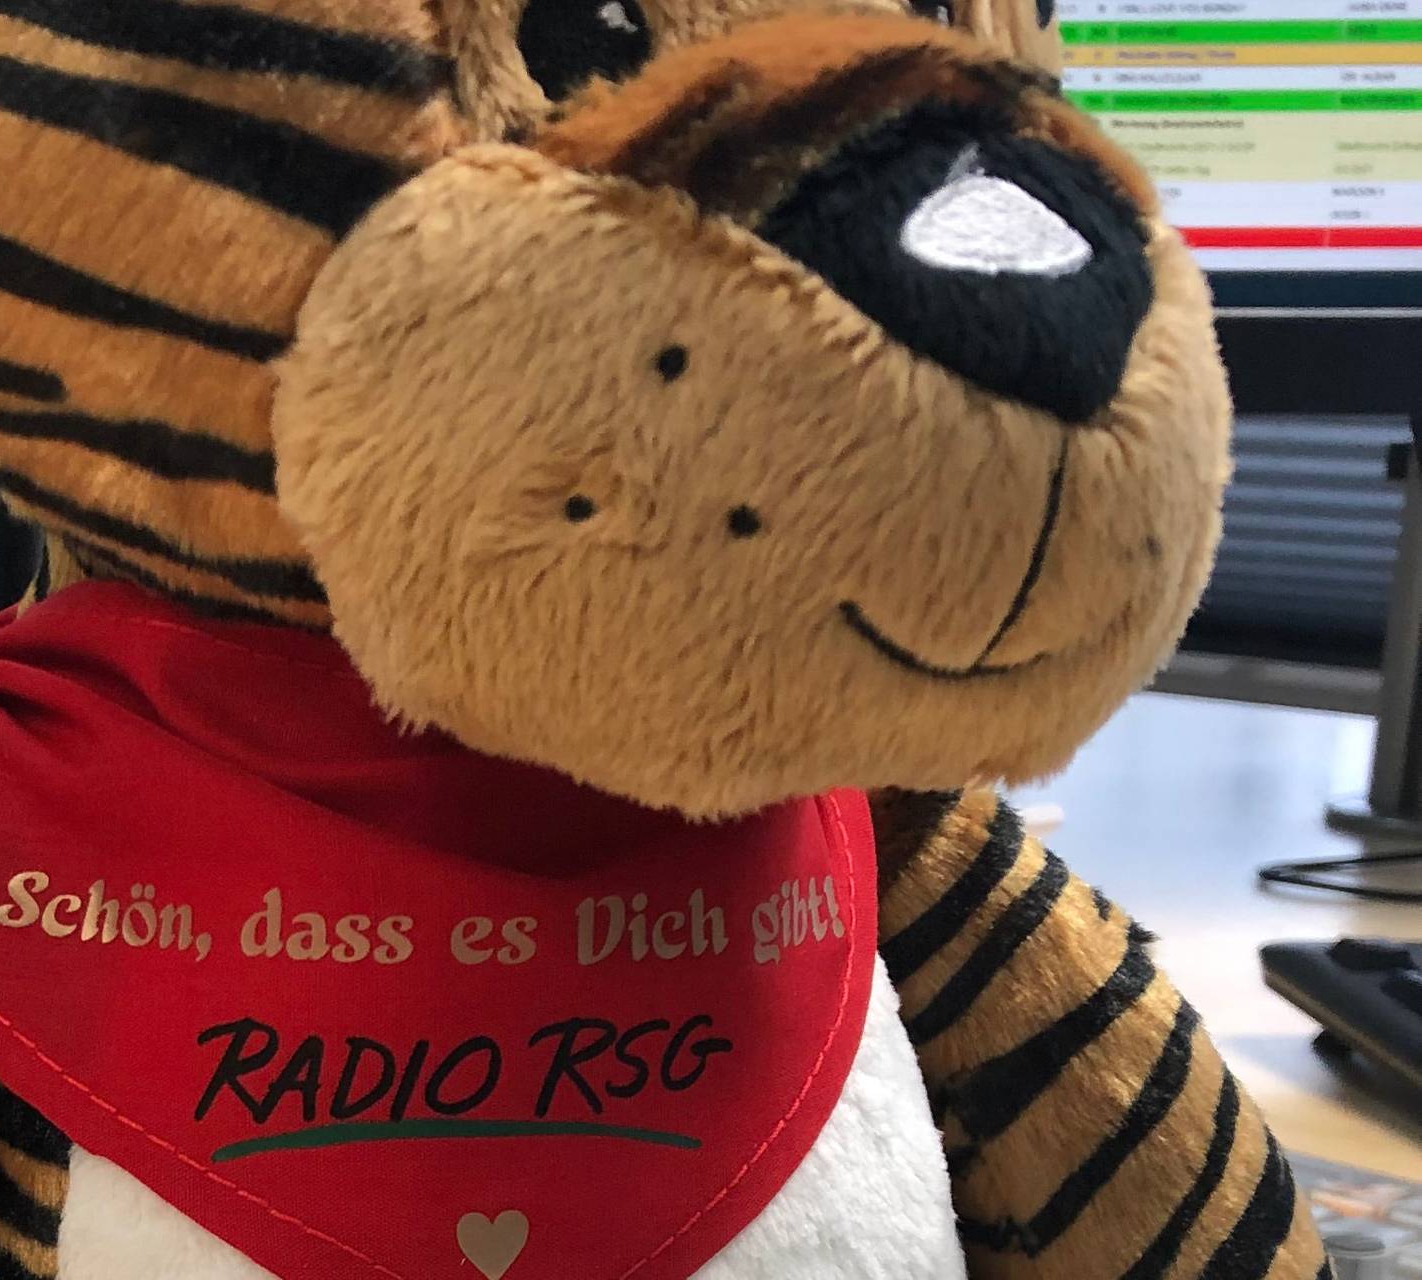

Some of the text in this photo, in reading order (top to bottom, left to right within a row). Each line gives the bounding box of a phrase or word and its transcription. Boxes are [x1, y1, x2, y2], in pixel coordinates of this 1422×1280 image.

[240, 887, 415, 965] dass
[450, 915, 538, 966] es
[576, 887, 729, 966] Dich
[752, 875, 845, 964] gibt!
[193, 1014, 734, 1124] RADIO RSG
